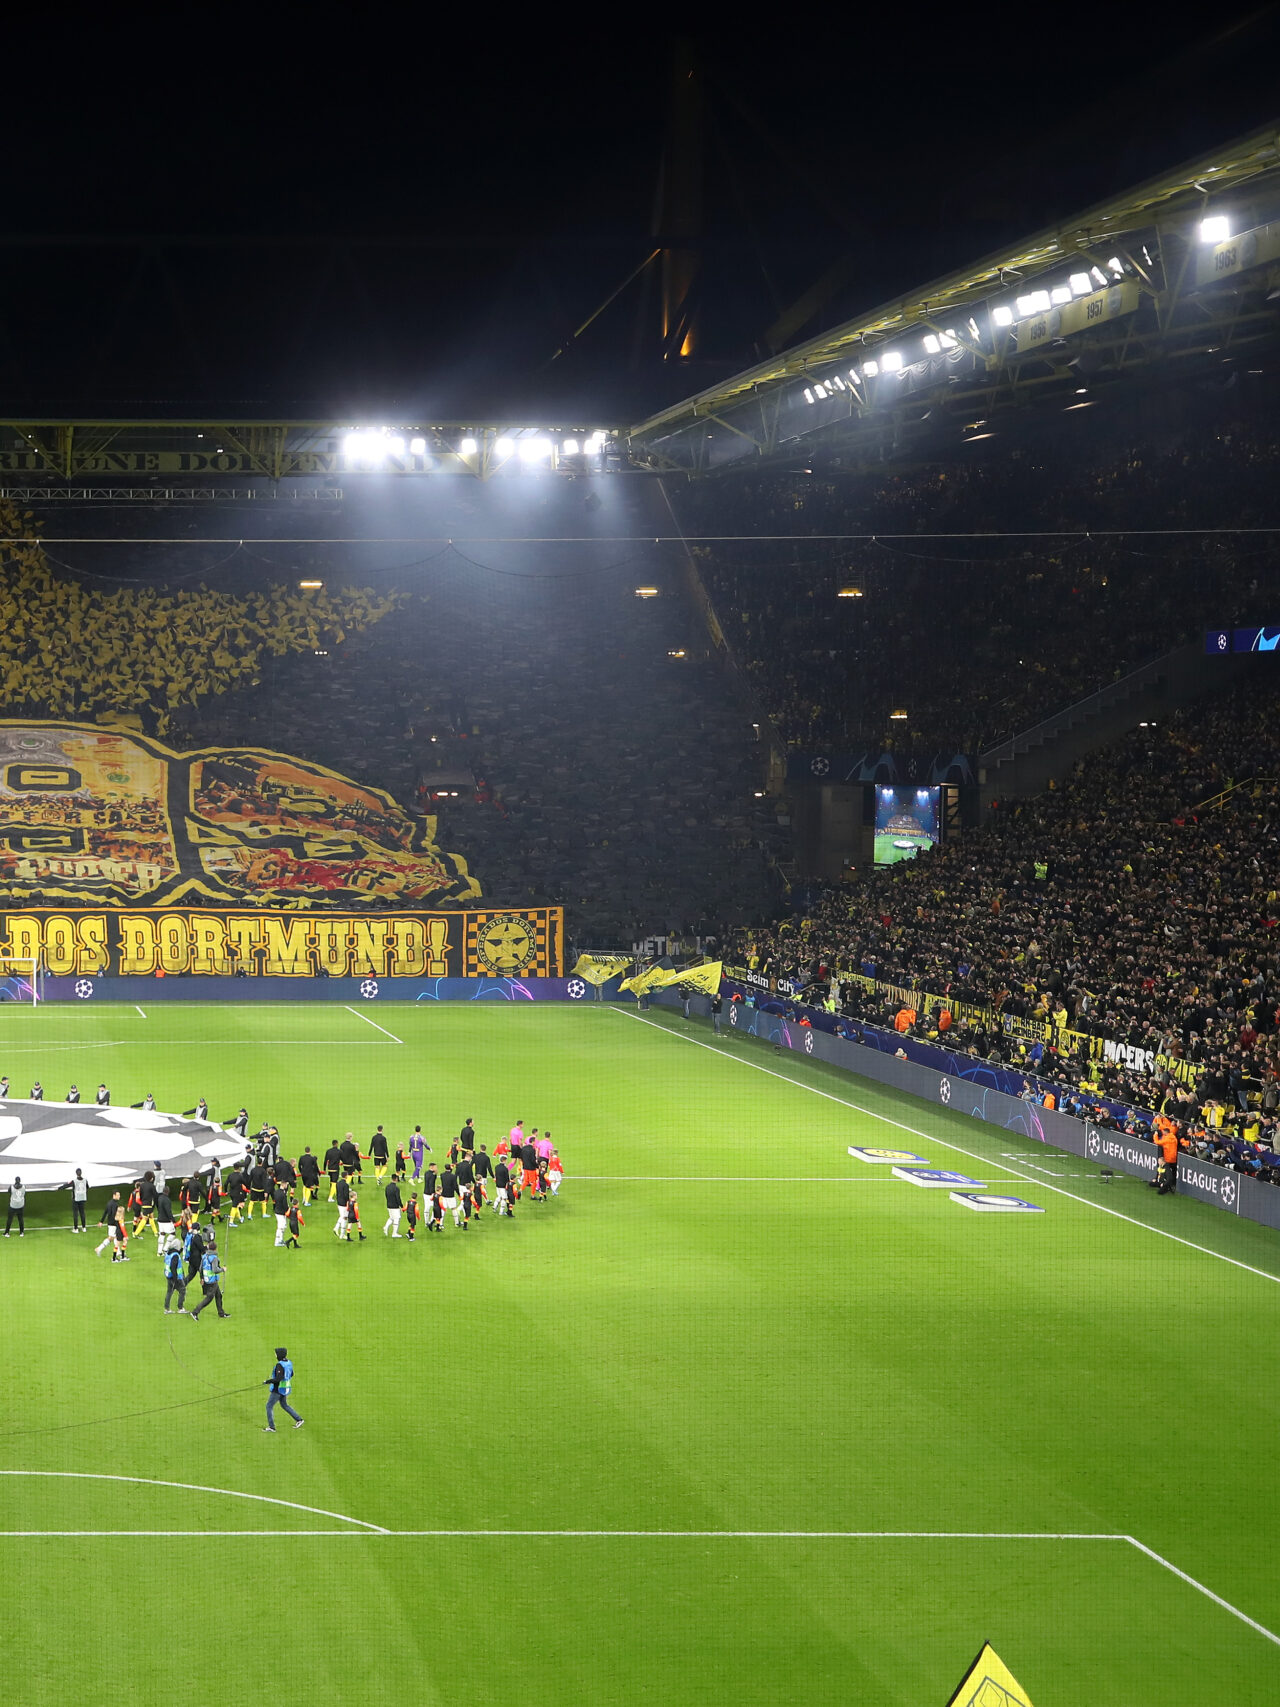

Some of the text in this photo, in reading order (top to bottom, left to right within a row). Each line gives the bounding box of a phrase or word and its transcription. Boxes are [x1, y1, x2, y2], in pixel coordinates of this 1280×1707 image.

[1214, 245, 1237, 271] 1963
[1086, 298, 1104, 321] 1957
[118, 915, 452, 978] DORTMUND!
[746, 969, 769, 989] Selm
[777, 978, 795, 996] City
[1103, 1039, 1155, 1073] MOERS
[1102, 1141, 1125, 1160] UEFA
[1182, 1172, 1218, 1194] LEAGUE
